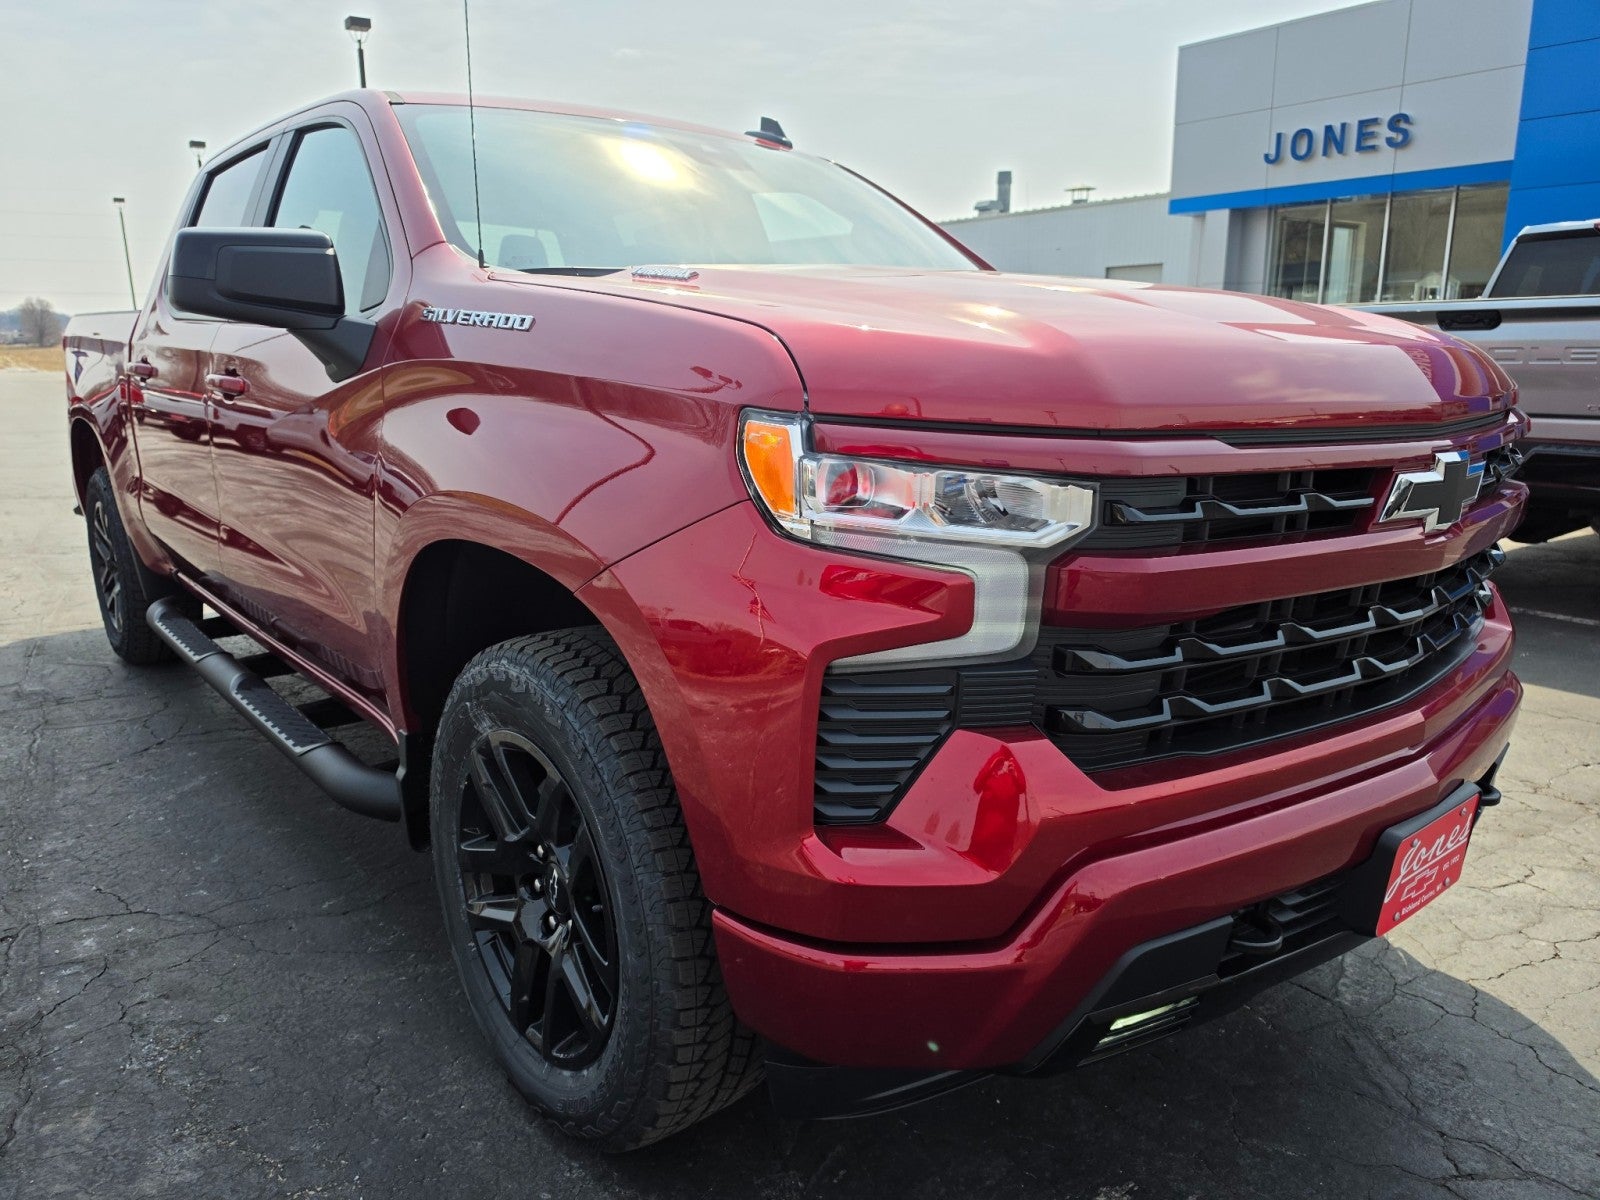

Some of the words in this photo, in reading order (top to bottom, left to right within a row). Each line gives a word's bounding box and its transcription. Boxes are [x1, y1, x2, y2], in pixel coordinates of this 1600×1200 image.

[1263, 113, 1414, 165] JONES
[421, 306, 536, 332] SILVERADO
[1384, 813, 1473, 904] Jones
